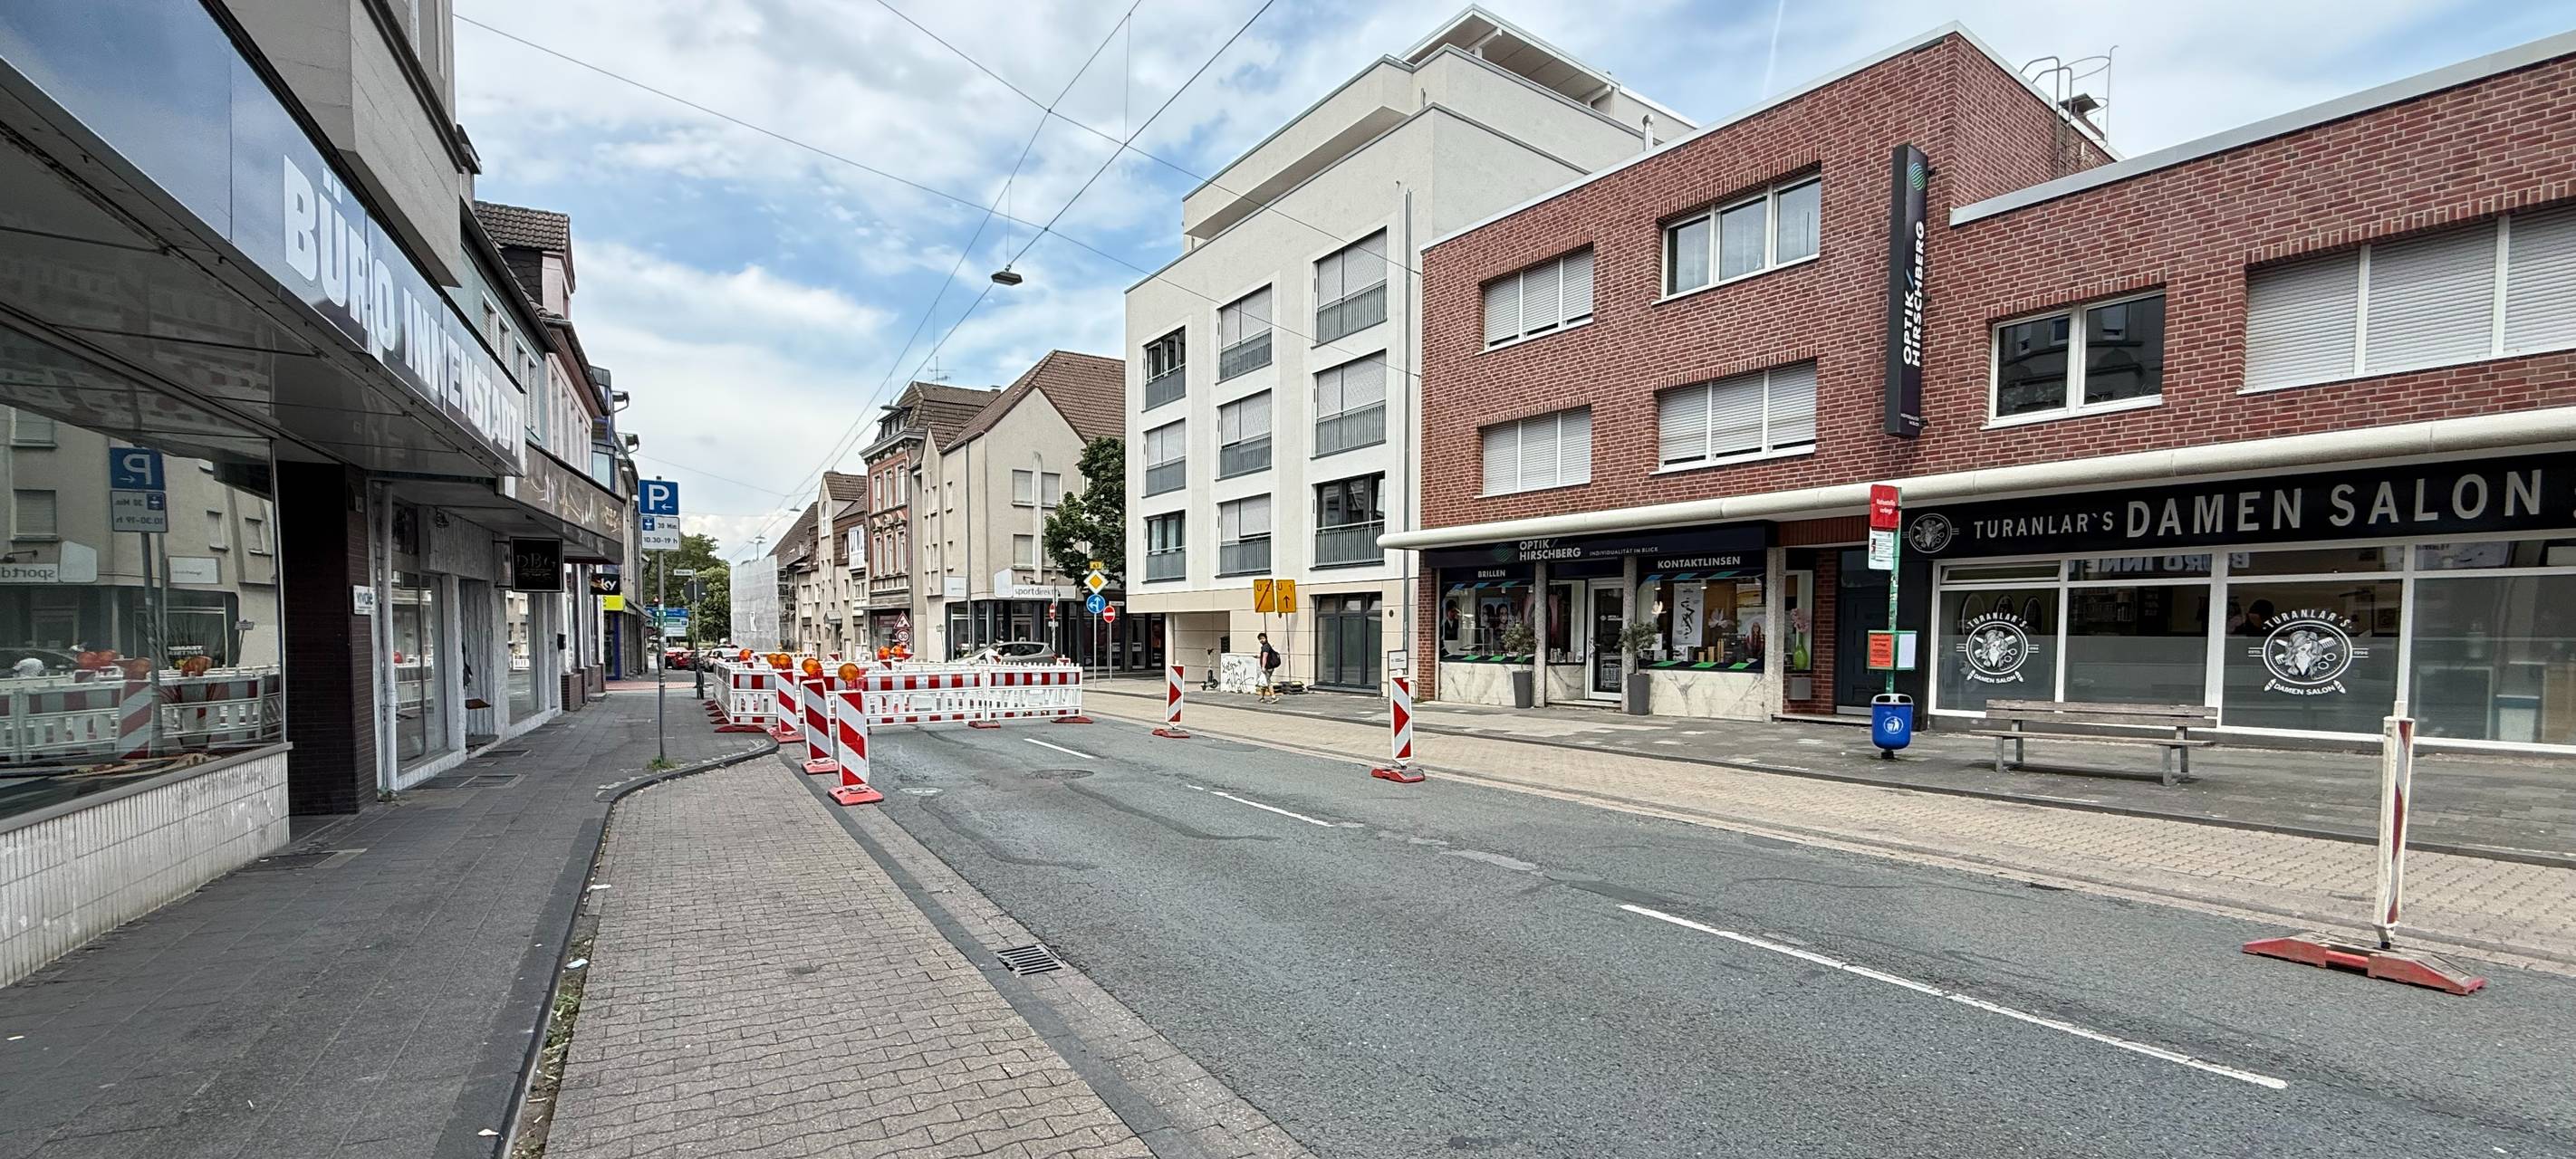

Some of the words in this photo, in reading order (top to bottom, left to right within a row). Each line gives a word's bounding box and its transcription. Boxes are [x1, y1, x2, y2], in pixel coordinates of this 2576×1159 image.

[1911, 220, 1925, 368] HIRSCHBERG
[284, 155, 396, 352] BÜRO
[403, 286, 518, 457] INNENSTADT
[1902, 290, 1914, 365] OPTIK
[649, 484, 669, 510] P
[2127, 488, 2302, 538] DAMEN
[2329, 469, 2542, 527] SALON
[1519, 539, 1550, 551] OPTIK
[1519, 548, 1581, 561] HIRSCHBERG
[1658, 556, 1741, 569] KONTAKTLINSEN
[1477, 570, 1505, 578] BRILLEN
[1974, 673, 1994, 683] DAMEN
[1995, 675, 2016, 684] SALON
[2273, 683, 2303, 694] DAMEN
[2306, 685, 2336, 695] SALON
